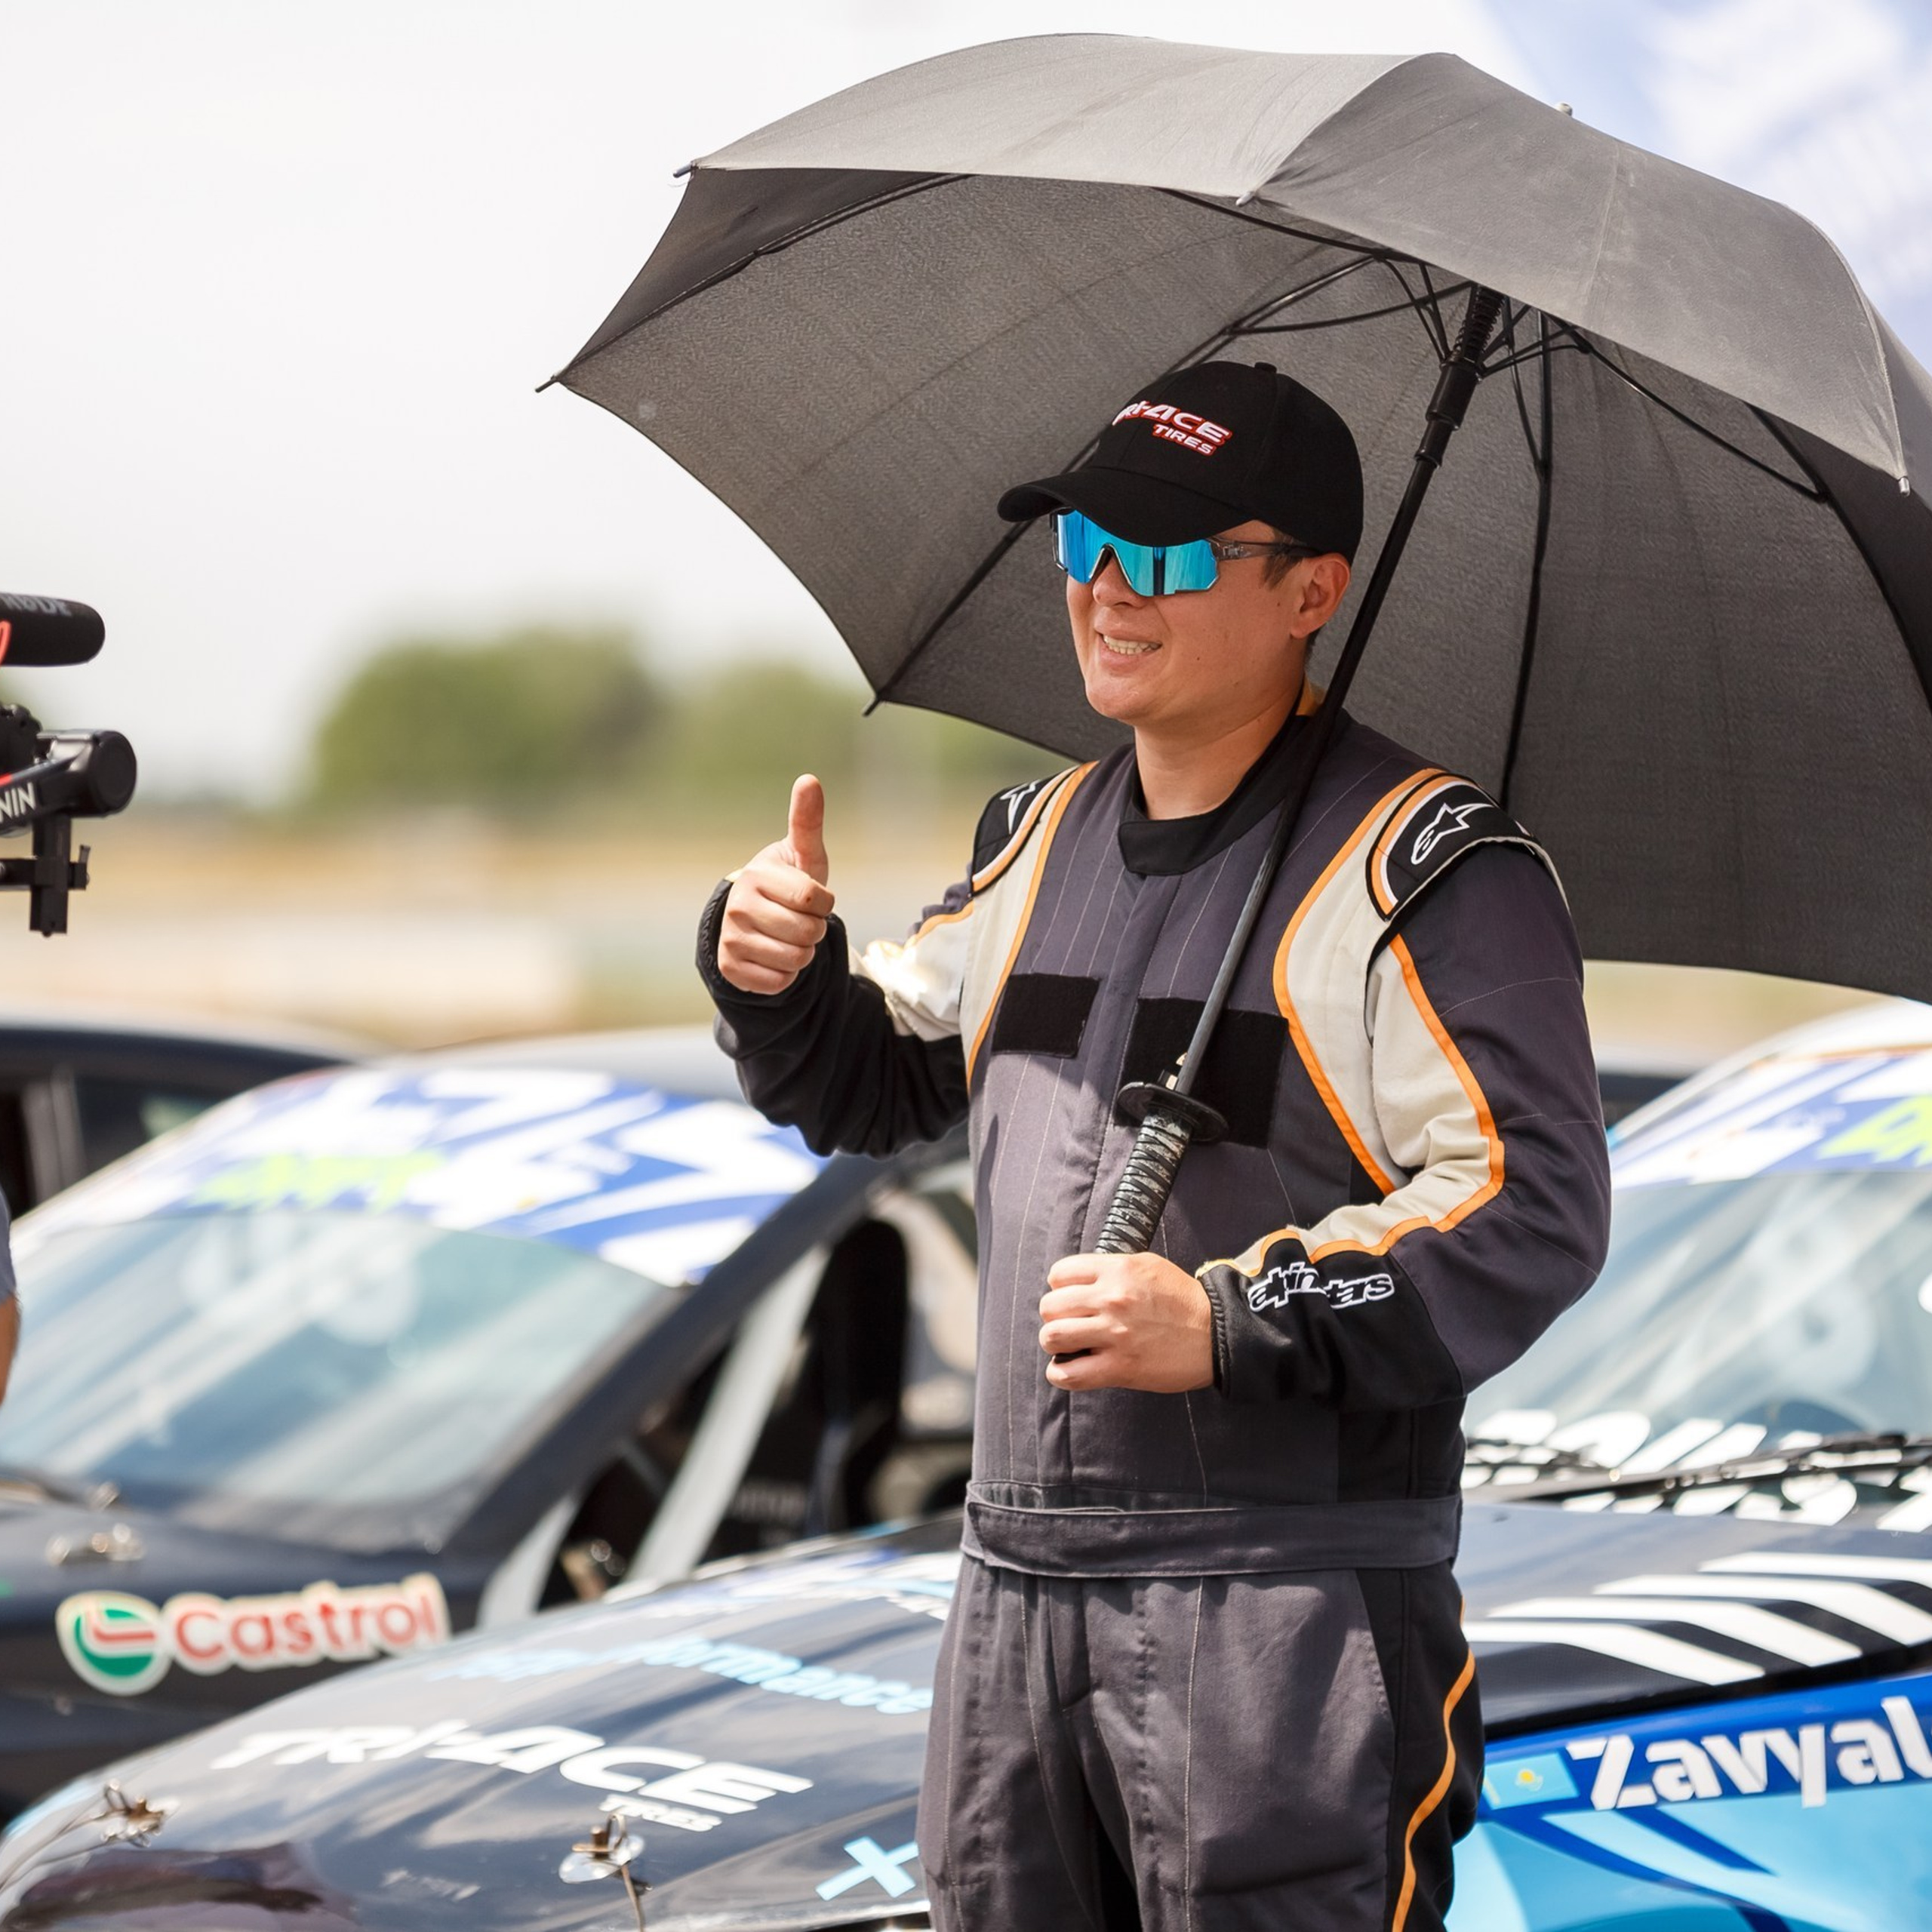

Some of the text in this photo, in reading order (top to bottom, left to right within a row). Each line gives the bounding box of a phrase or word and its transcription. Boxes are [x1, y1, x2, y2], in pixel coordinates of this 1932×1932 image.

[1153, 423, 1215, 454] TIRES
[171, 1589, 441, 1664] Castrol
[210, 1719, 814, 1815] TRI-ACE
[1565, 1695, 1932, 1810] Zavyal
